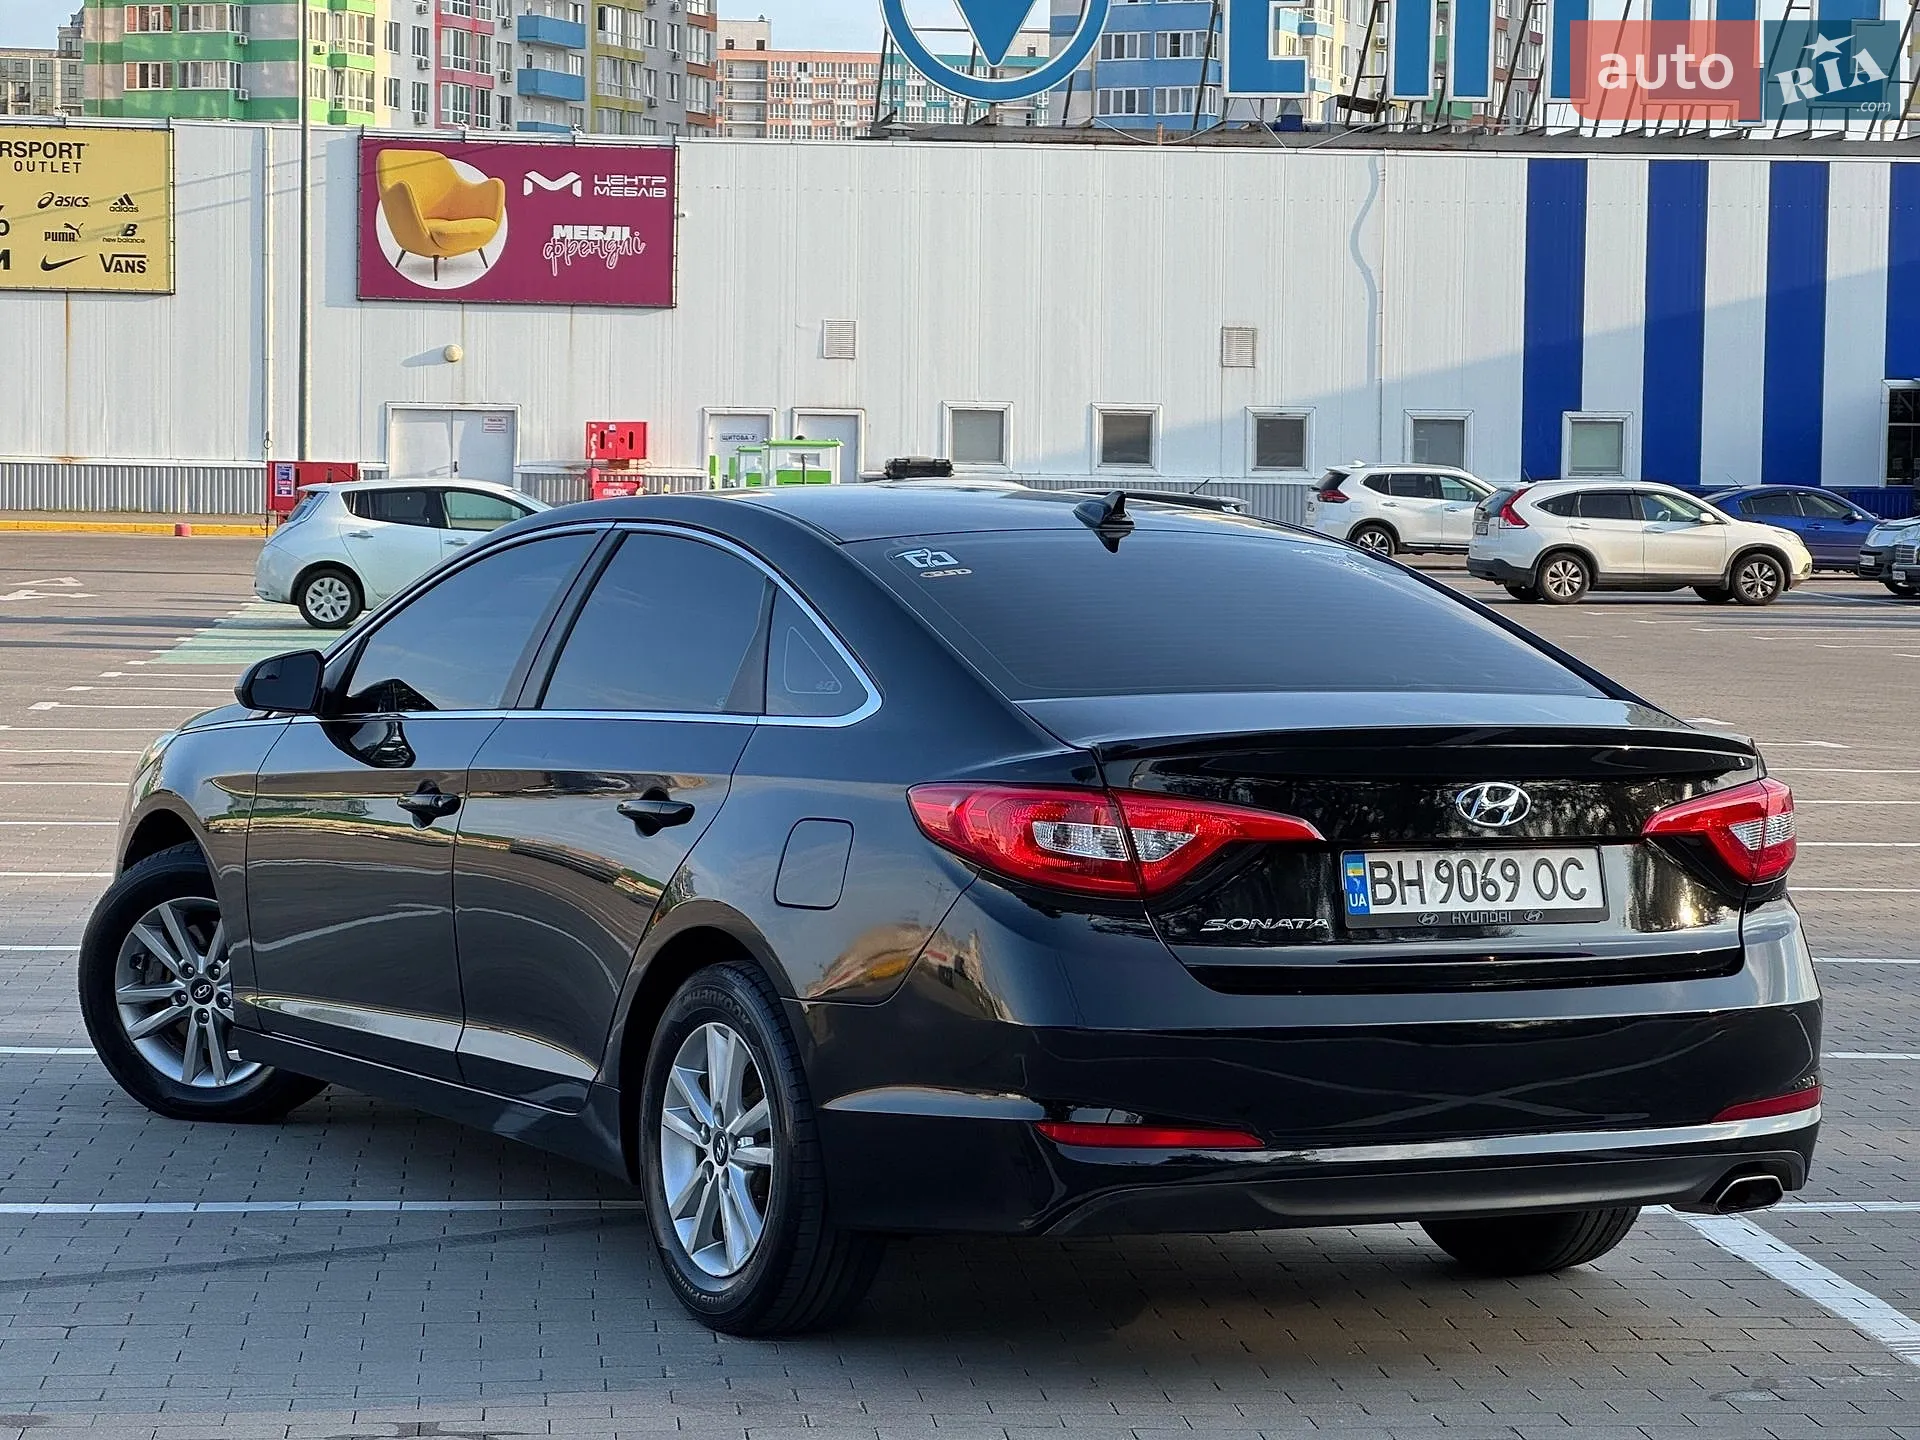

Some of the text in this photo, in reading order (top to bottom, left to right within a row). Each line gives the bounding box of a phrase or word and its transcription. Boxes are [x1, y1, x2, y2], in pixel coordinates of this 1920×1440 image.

[14, 161, 82, 173] OUTLET
[594, 174, 667, 187] ЦЕНТР
[594, 186, 667, 198] МЕБЛІВ
[54, 194, 90, 208] asics
[109, 204, 139, 213] adidas
[44, 231, 77, 242] PUMA
[553, 225, 631, 240] МЕБЛІ
[118, 236, 146, 244] balance
[99, 254, 147, 273] VANS
[1368, 857, 1588, 906] BH 9069 OC
[1350, 893, 1368, 908] UA
[1451, 910, 1513, 924] HYUNDAI
[1200, 918, 1330, 932] SONATA
